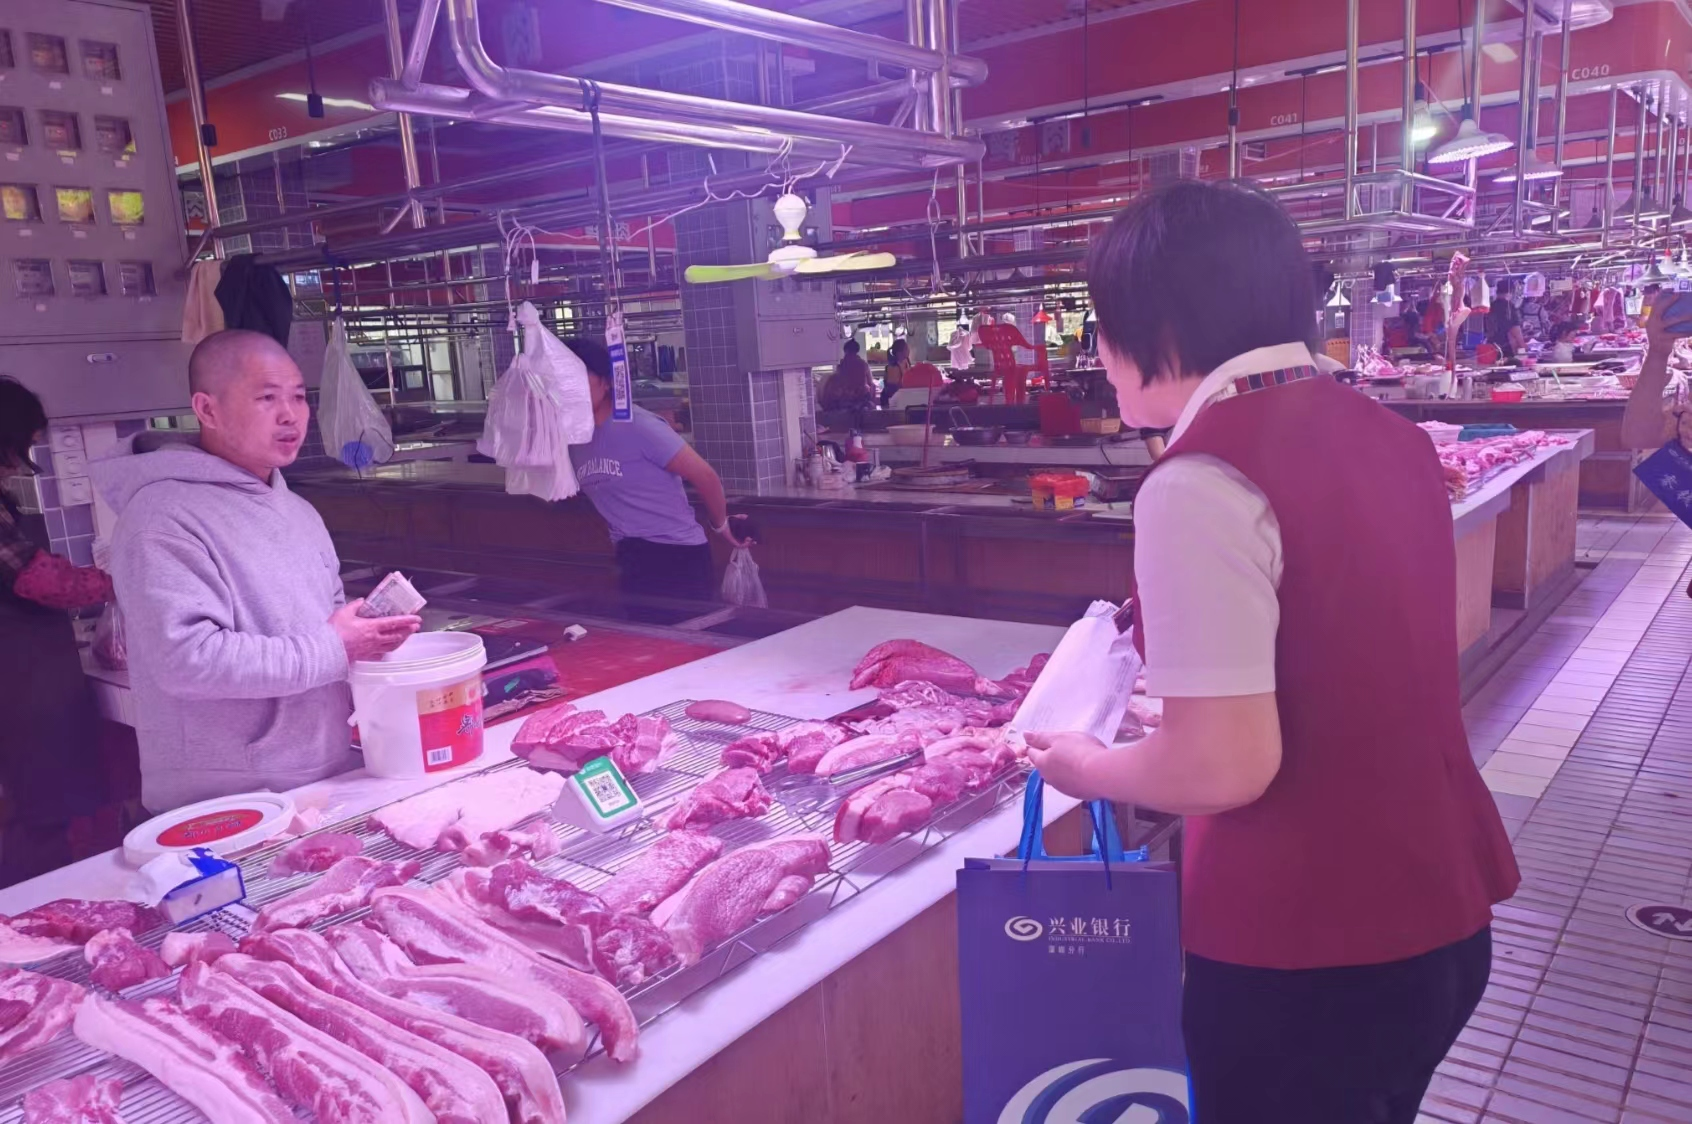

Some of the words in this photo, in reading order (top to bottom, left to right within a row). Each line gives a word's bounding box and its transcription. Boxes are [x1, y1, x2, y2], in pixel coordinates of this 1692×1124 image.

[1571, 64, 1610, 80] C040
[1270, 112, 1297, 125] C041
[268, 126, 287, 141] C033
[587, 456, 623, 477] BALANCE
[1048, 917, 1131, 936] 兴业银行
